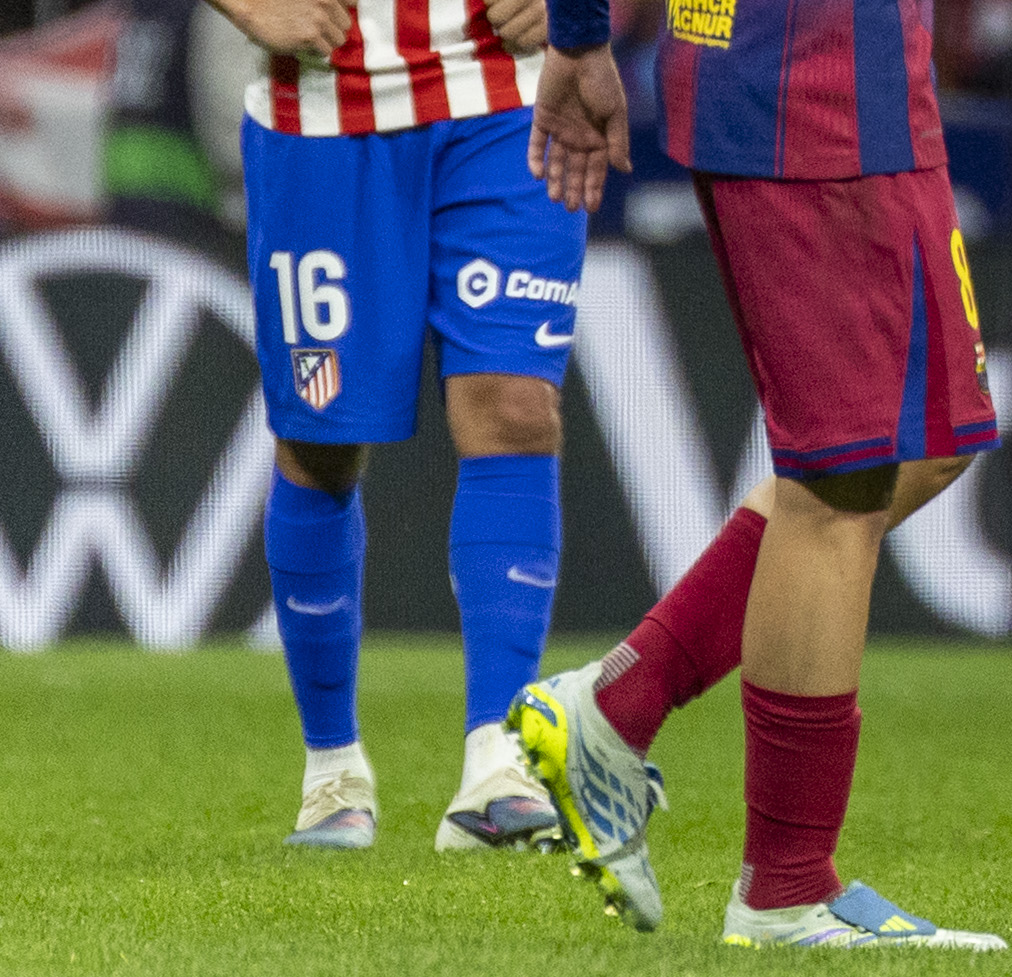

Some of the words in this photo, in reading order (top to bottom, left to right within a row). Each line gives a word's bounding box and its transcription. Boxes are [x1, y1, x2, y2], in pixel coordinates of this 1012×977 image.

[673, 9, 734, 40] ACNUR
[269, 249, 351, 345] 16
[950, 228, 980, 331] 8
